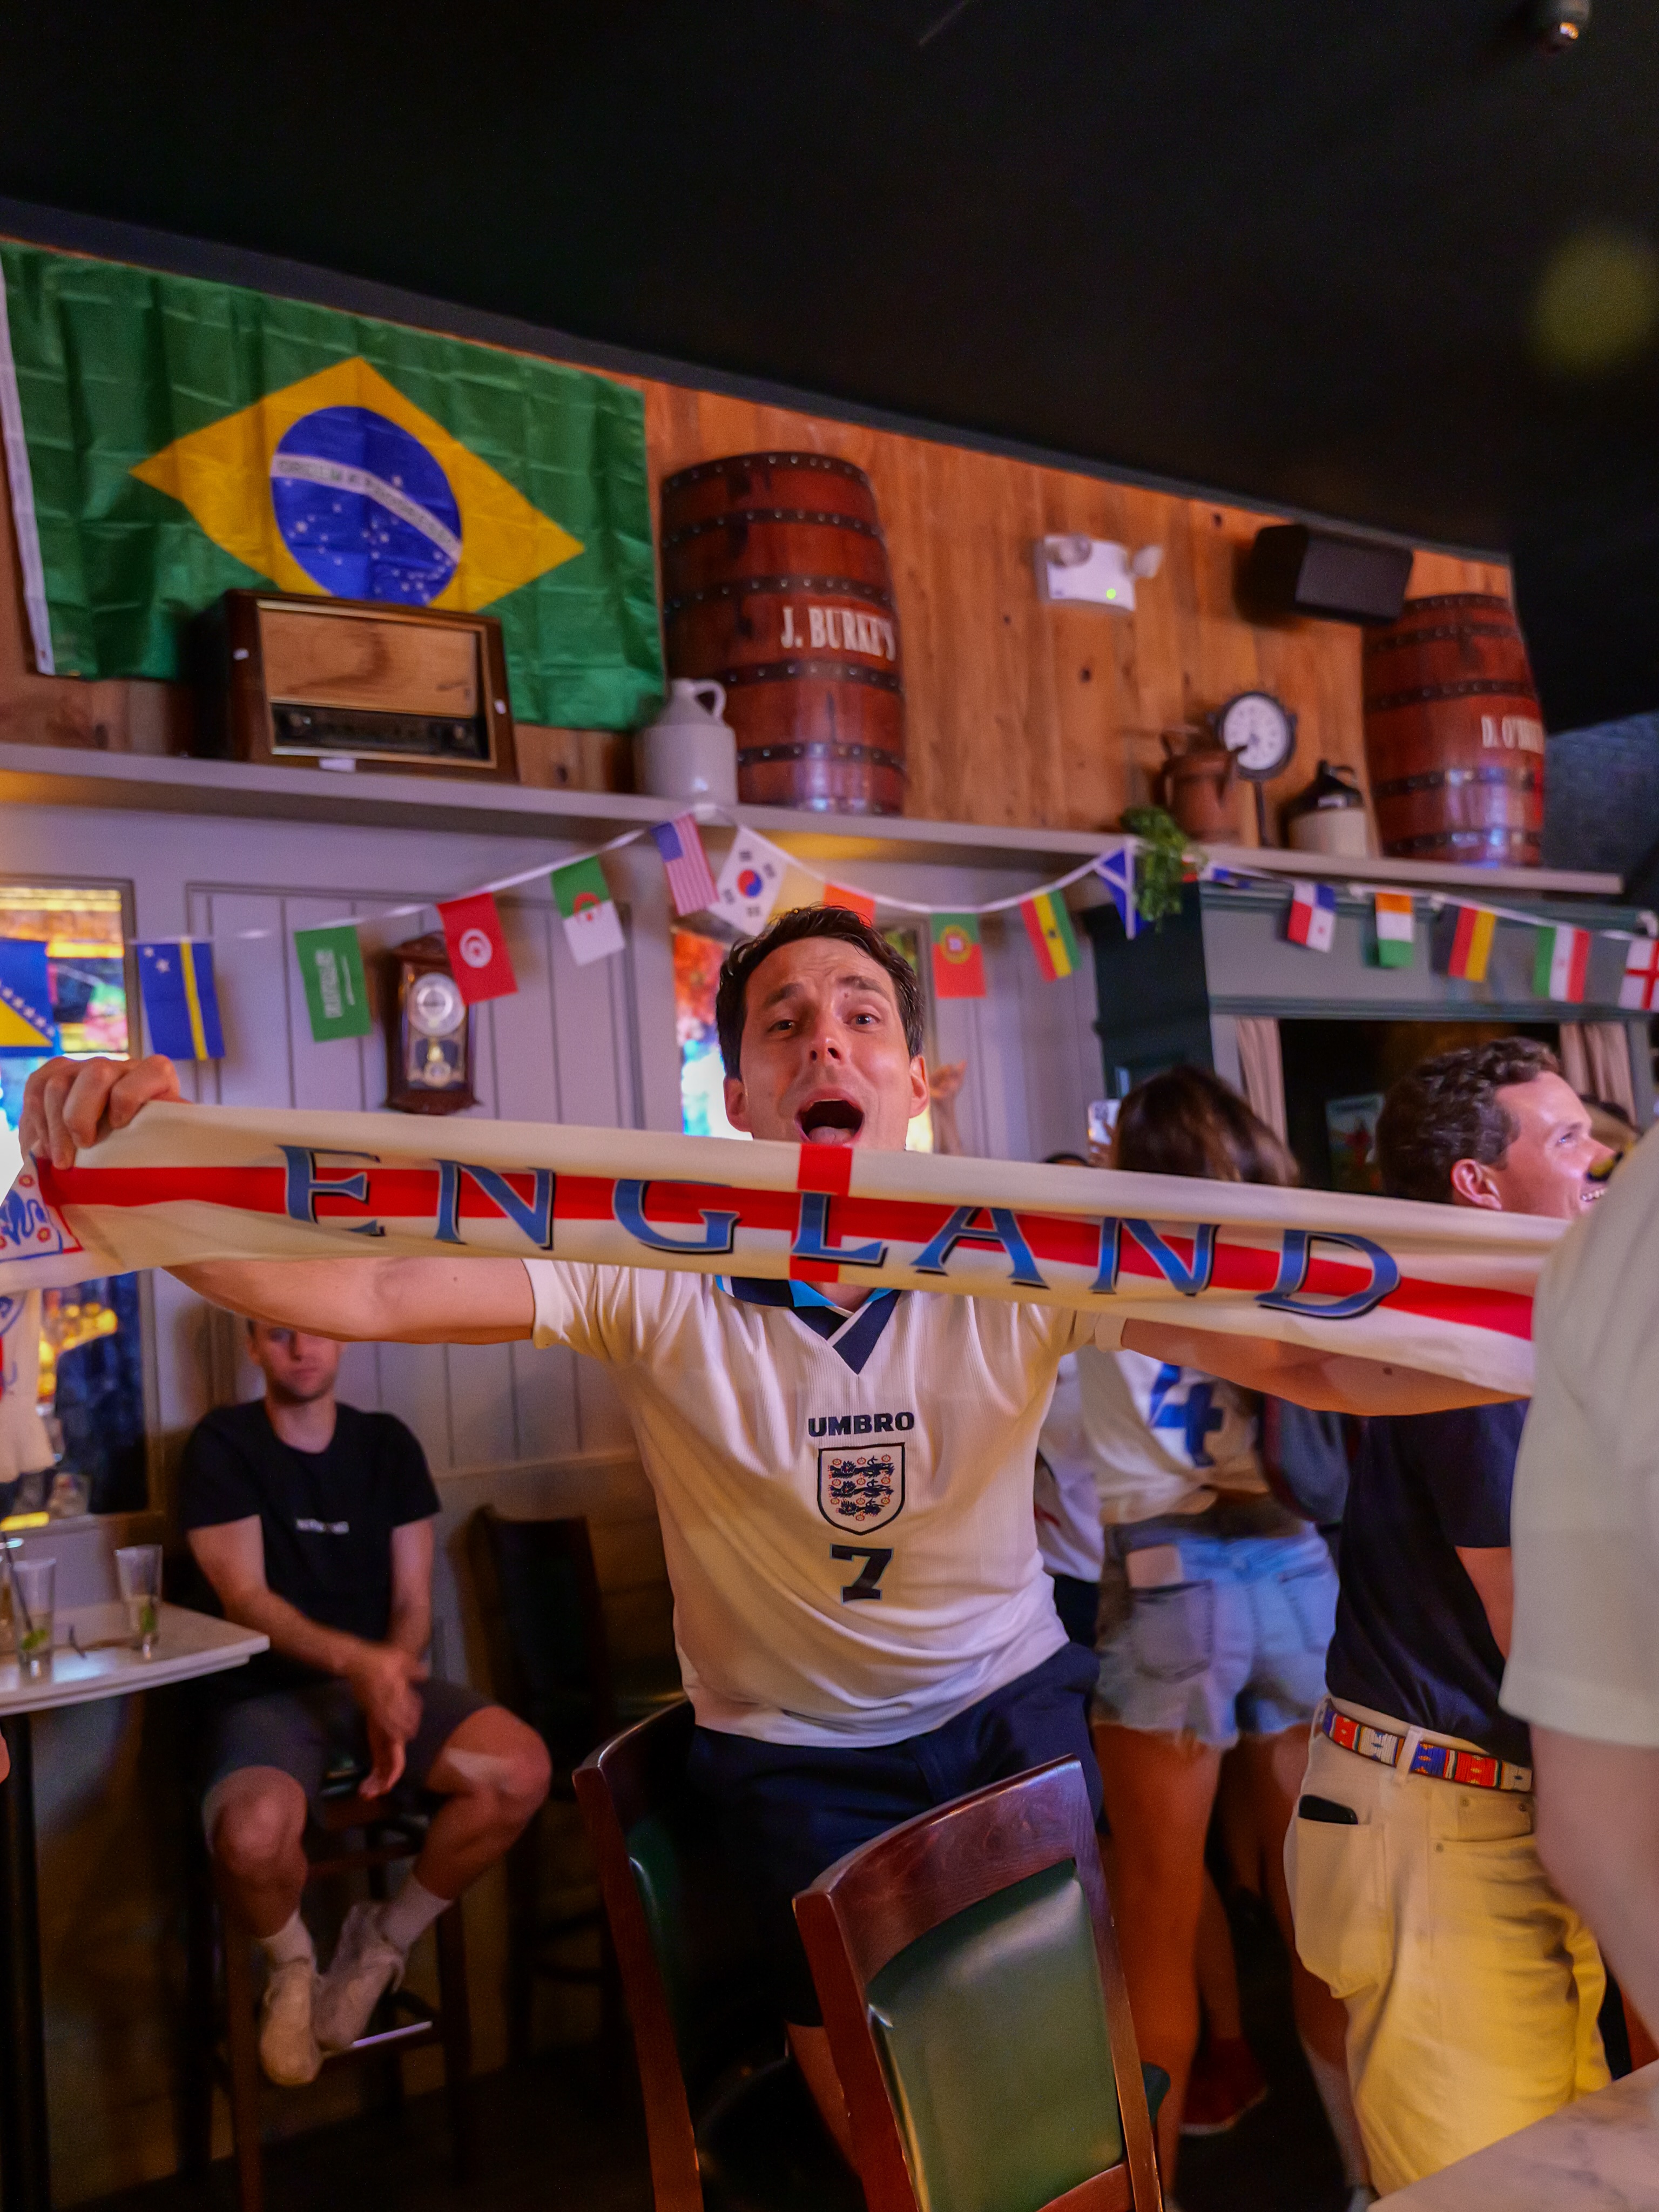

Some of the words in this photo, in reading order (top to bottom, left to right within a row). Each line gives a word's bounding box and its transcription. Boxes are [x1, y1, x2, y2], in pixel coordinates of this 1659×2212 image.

[780, 606, 803, 649] J.
[274, 1143, 1400, 1319] ENGLAND
[808, 1412, 914, 1437] UMBRO
[830, 1543, 894, 1605] 7
